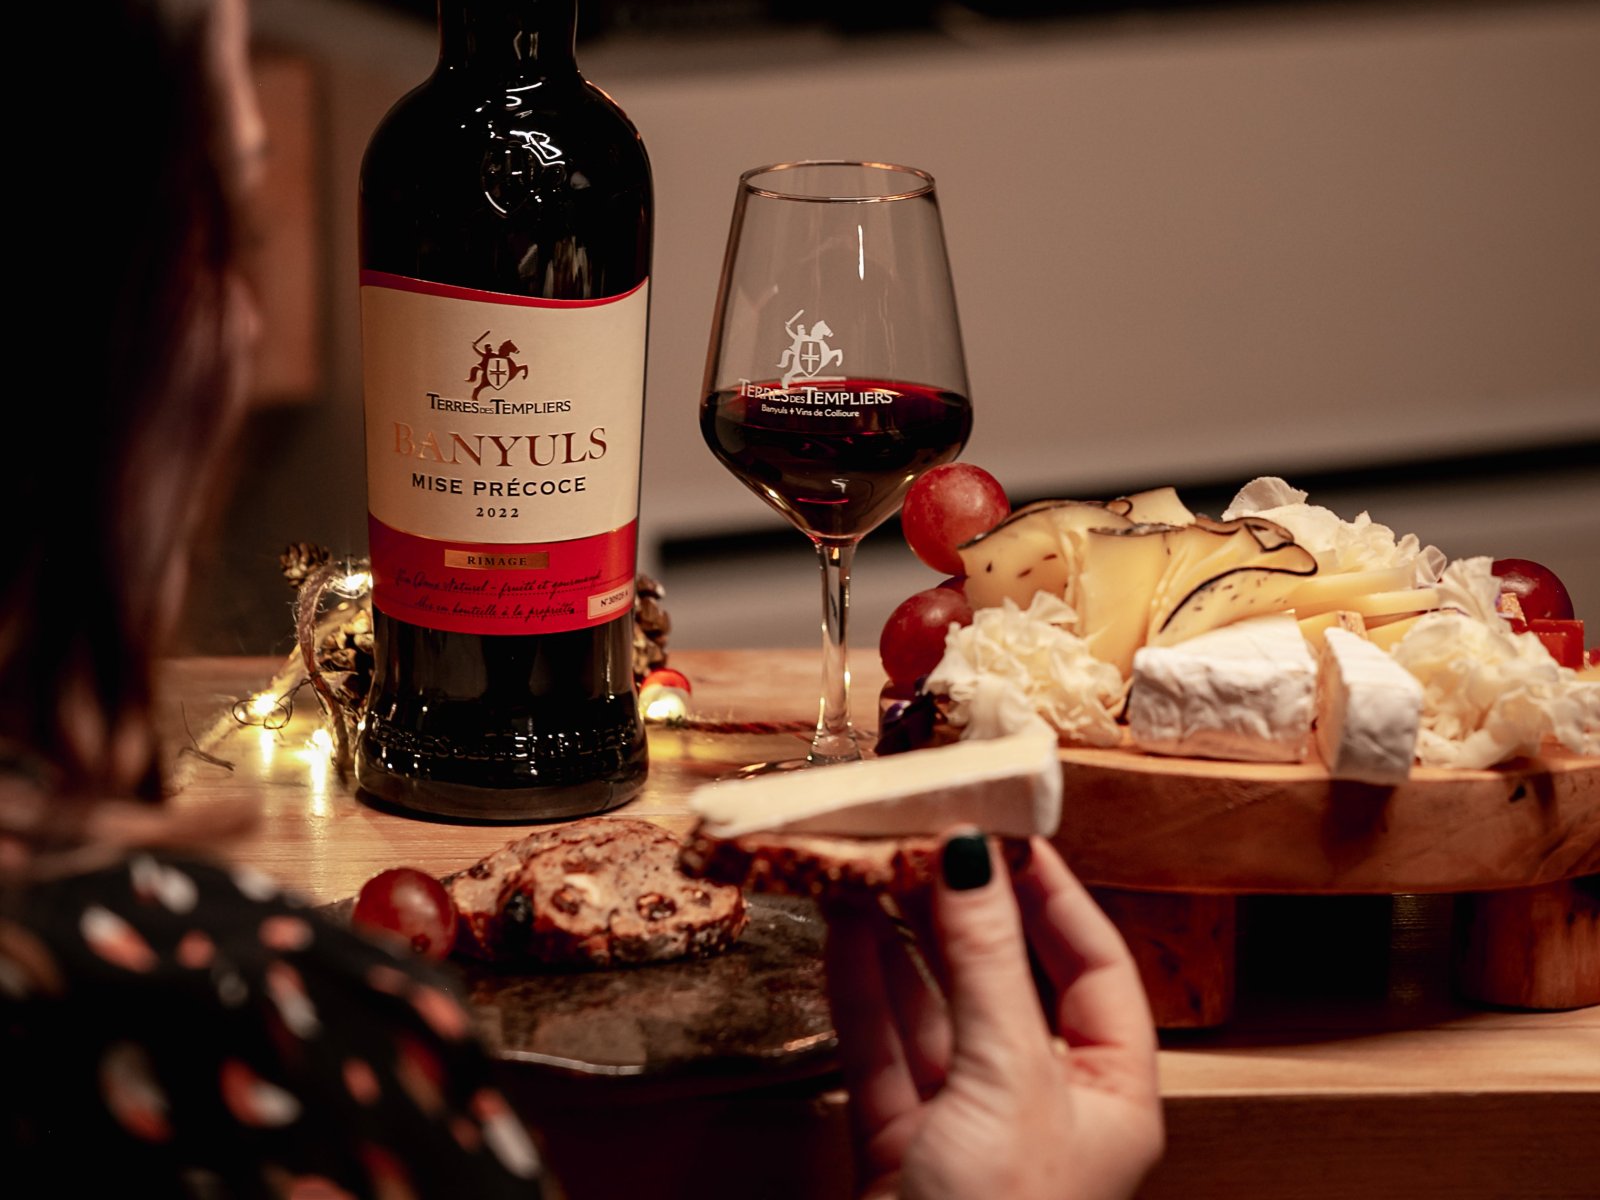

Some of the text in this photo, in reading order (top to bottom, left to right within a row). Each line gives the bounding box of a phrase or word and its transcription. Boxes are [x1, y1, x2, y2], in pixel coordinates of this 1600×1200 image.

[426, 392, 479, 413] TERRES
[490, 399, 571, 415] TEMPLIERS
[761, 403, 860, 417] Banyuls Vins de Collioure
[393, 422, 607, 467] BANYULS
[412, 473, 587, 497] MISE PRÉCOCE
[475, 507, 519, 518] 2022
[467, 556, 527, 566] RIMAGE
[537, 580, 550, 590] et
[452, 601, 497, 616] bouteille
[513, 603, 524, 616] la
